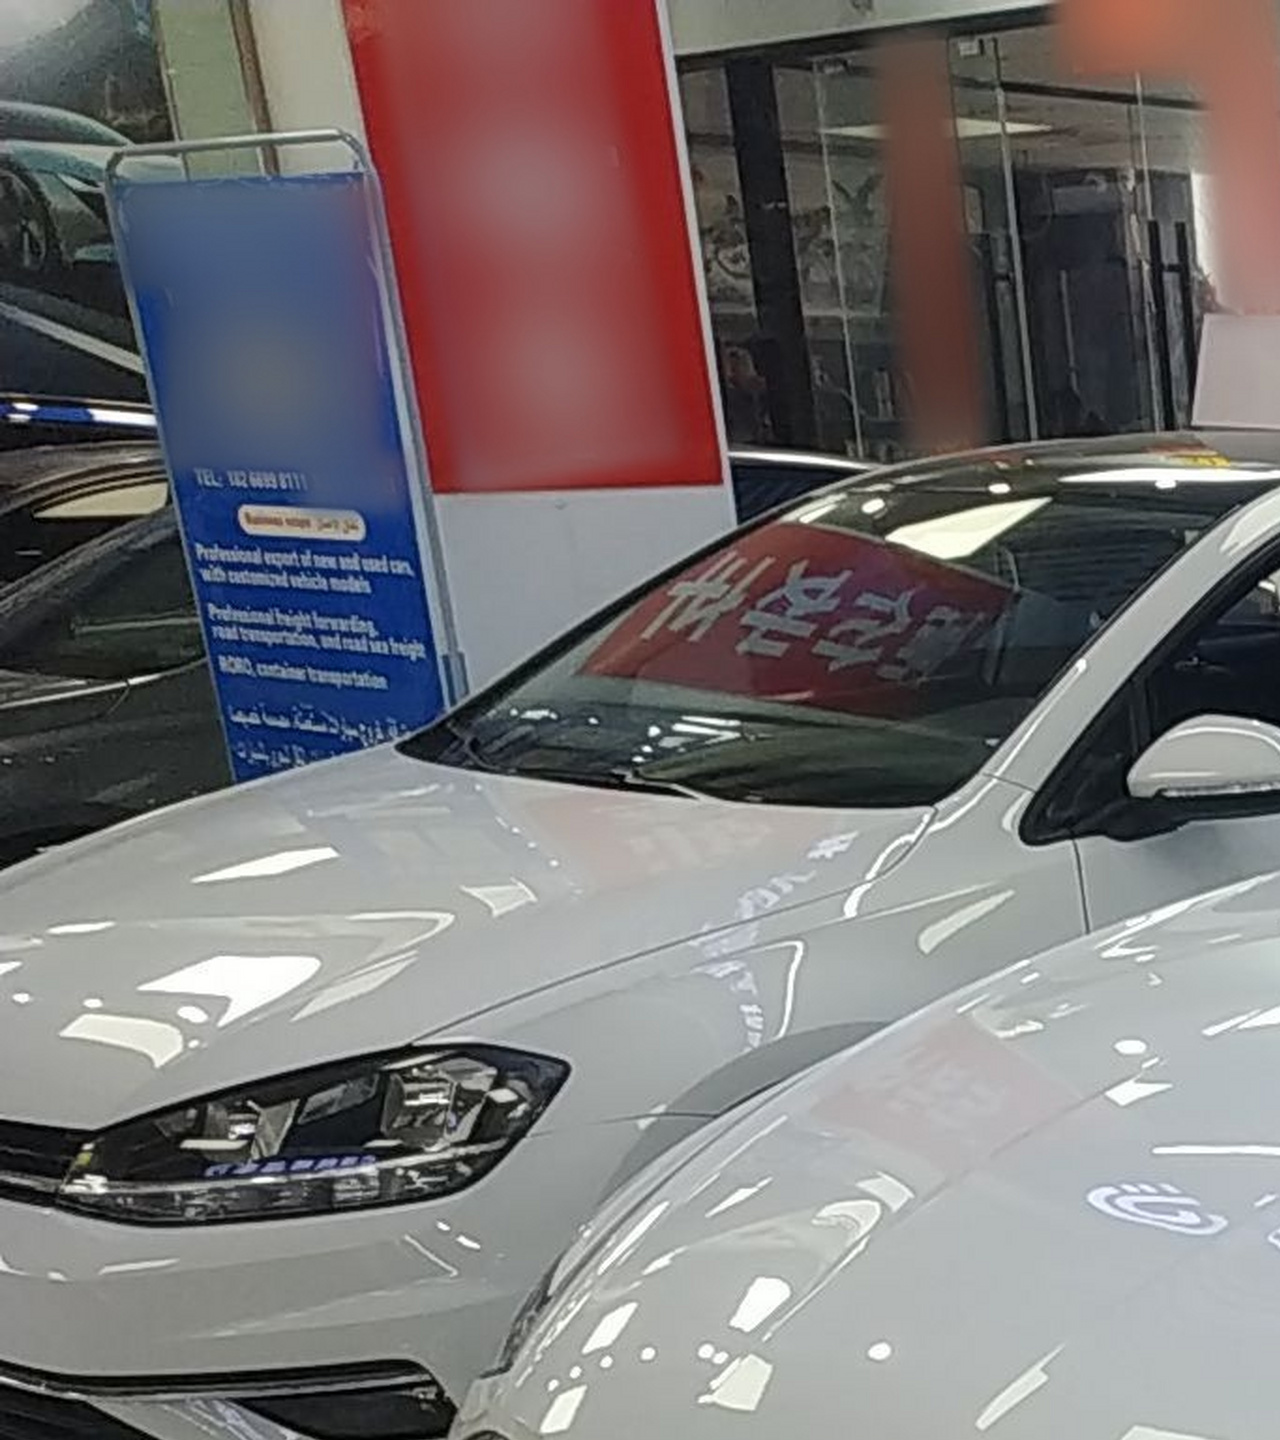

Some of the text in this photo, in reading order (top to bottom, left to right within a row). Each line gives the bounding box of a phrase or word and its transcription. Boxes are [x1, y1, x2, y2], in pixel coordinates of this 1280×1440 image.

[194, 543, 262, 565] Professional
[263, 550, 299, 569] export
[300, 549, 312, 566] of
[313, 555, 338, 569] new
[339, 552, 361, 571] and
[362, 555, 388, 574] used
[200, 565, 226, 582] with
[228, 569, 288, 589] customized
[290, 571, 329, 592] vehicle
[207, 602, 275, 625] Professional
